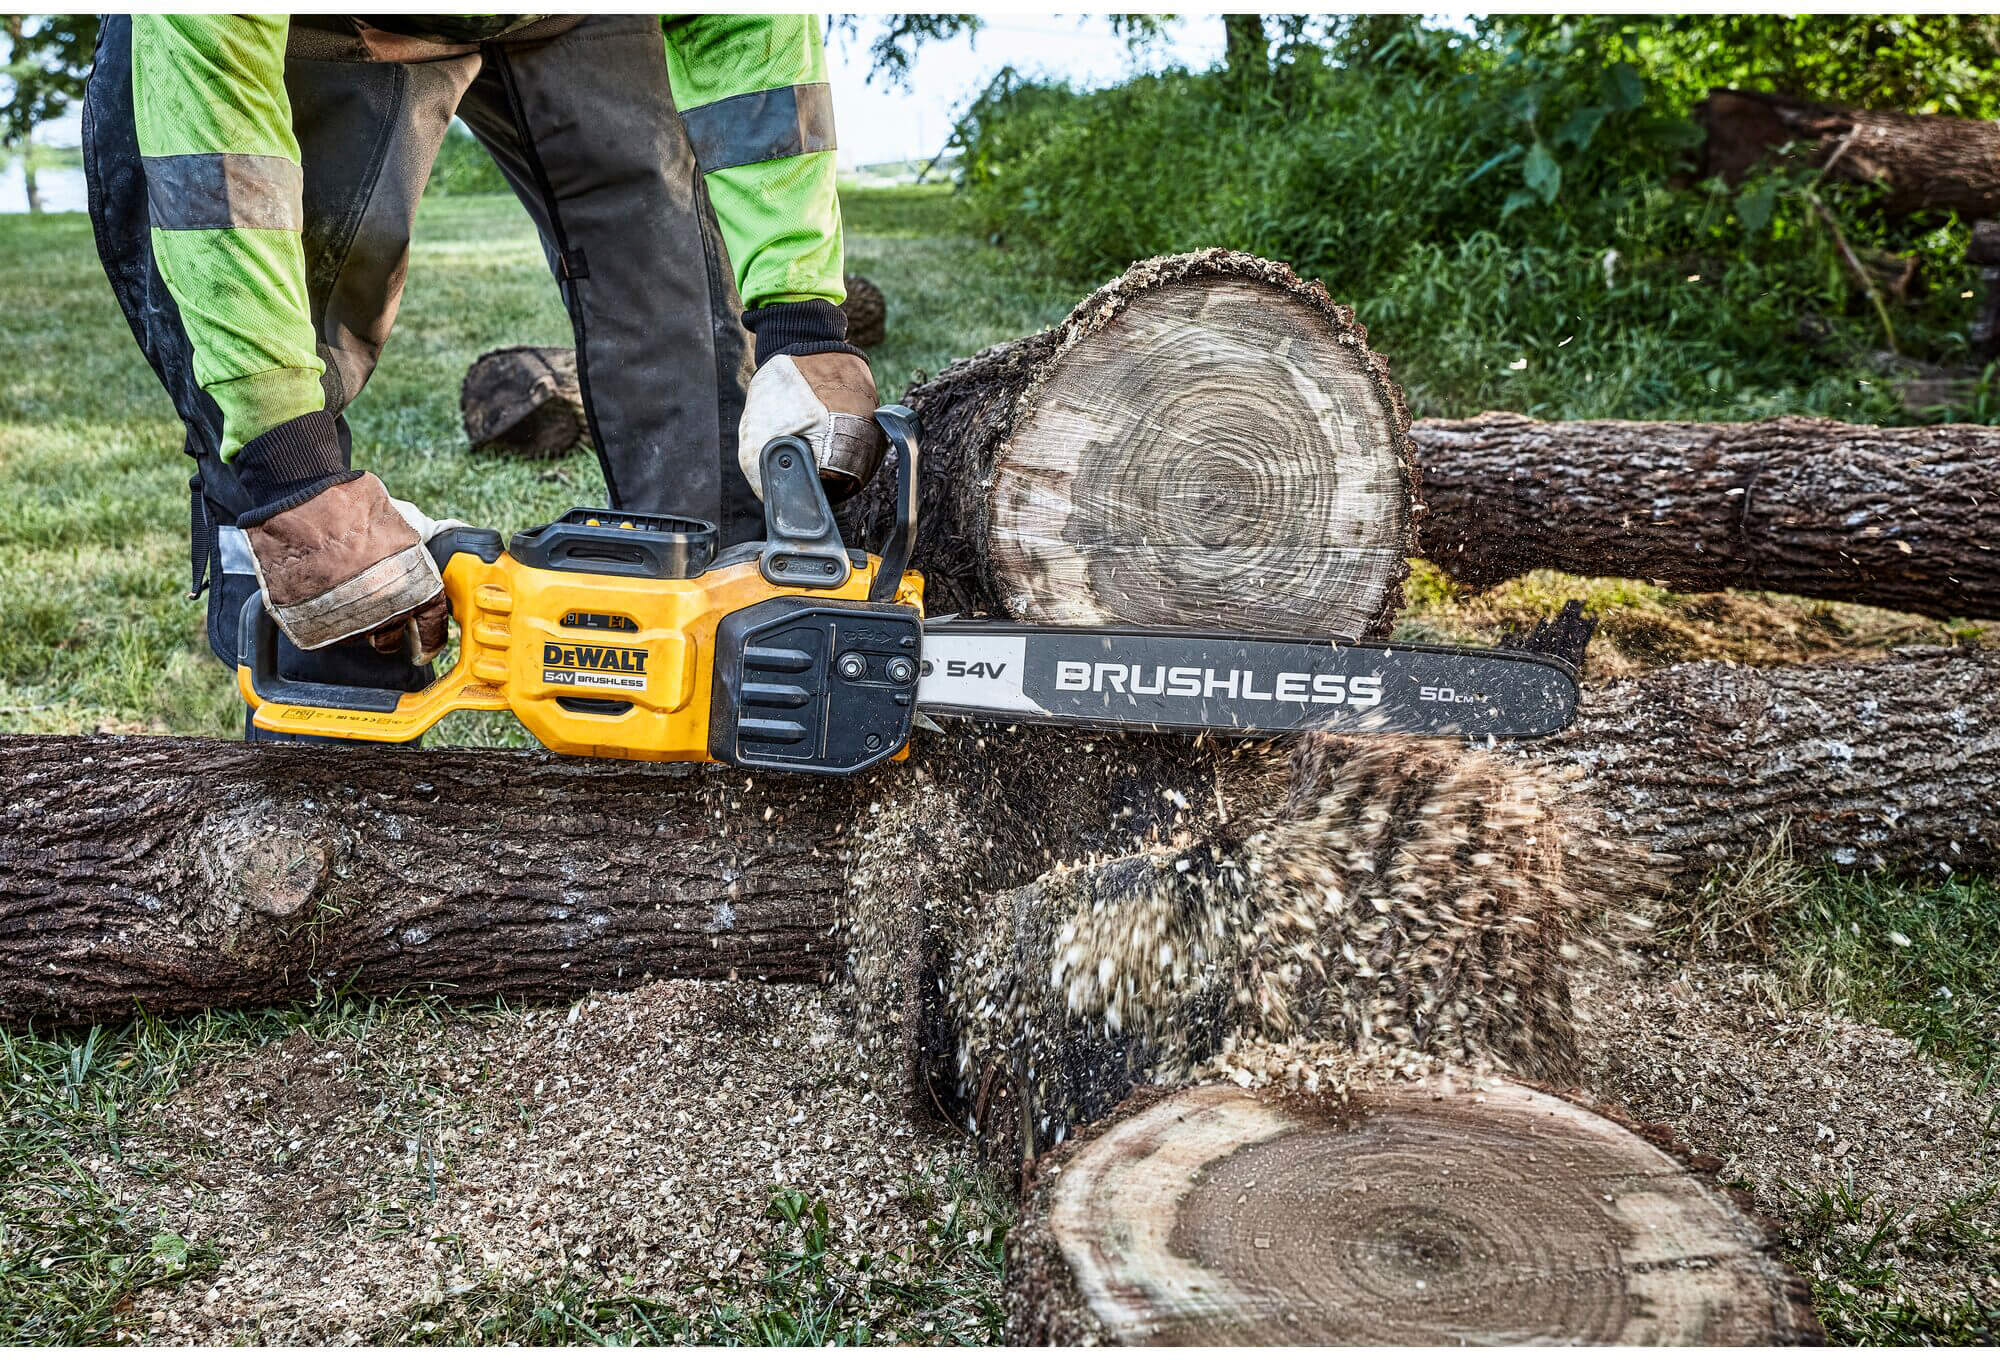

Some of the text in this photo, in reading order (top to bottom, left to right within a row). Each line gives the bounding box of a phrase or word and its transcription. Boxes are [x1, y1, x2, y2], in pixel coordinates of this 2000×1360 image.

[545, 671, 643, 687] 54V BRUSHLESS
[946, 660, 1006, 679] 54V
[1055, 660, 1383, 705] BRUSHLESS
